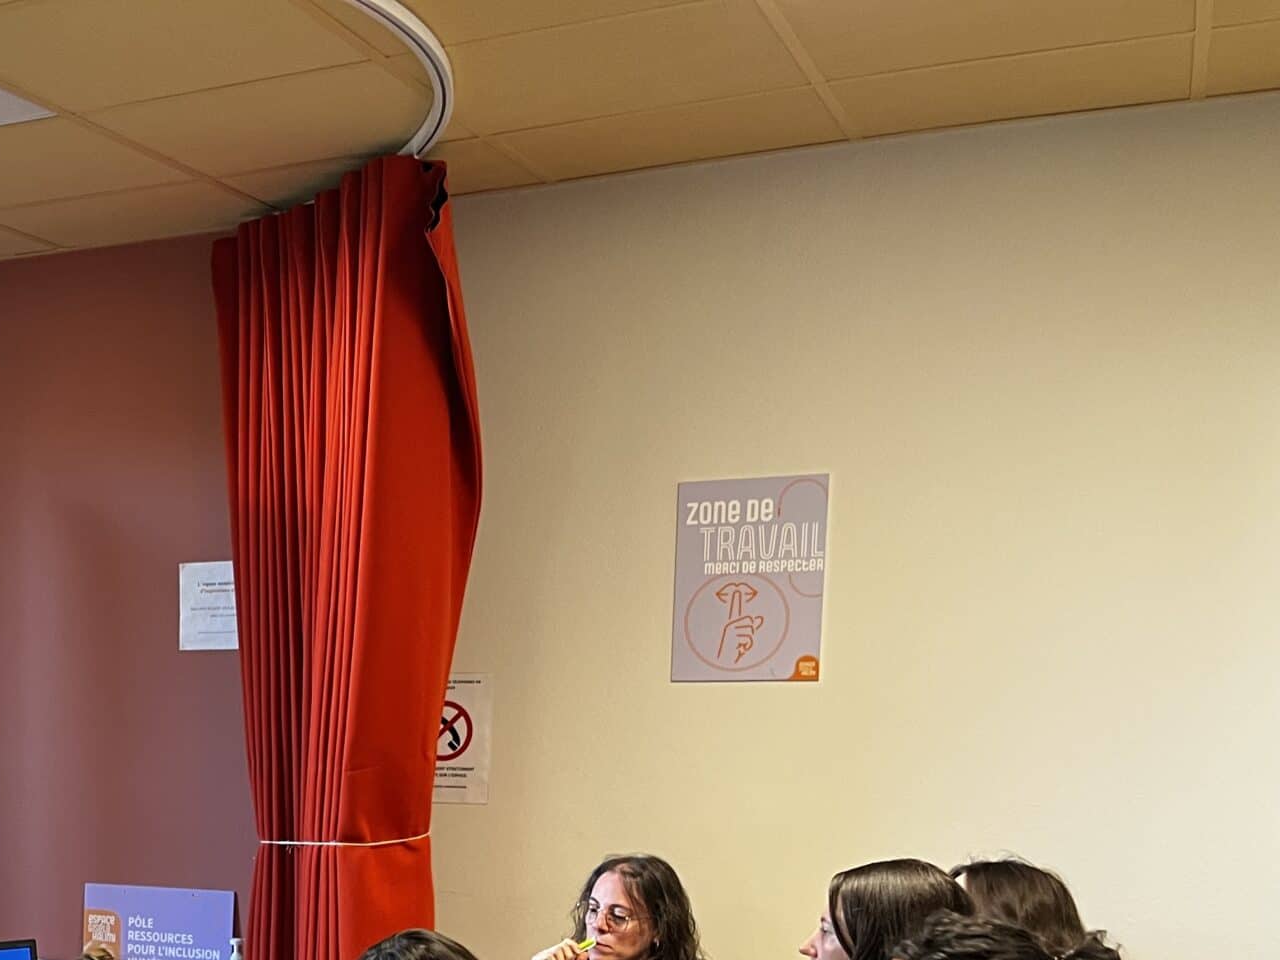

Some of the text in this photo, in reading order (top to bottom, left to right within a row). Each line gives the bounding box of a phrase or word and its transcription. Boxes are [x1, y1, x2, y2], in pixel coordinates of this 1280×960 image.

[700, 522, 825, 562] TRAVAIL
[128, 915, 153, 929] PÔLE
[127, 930, 194, 944] RESSOURCES
[127, 944, 220, 960] POUR L'INCLUSION
